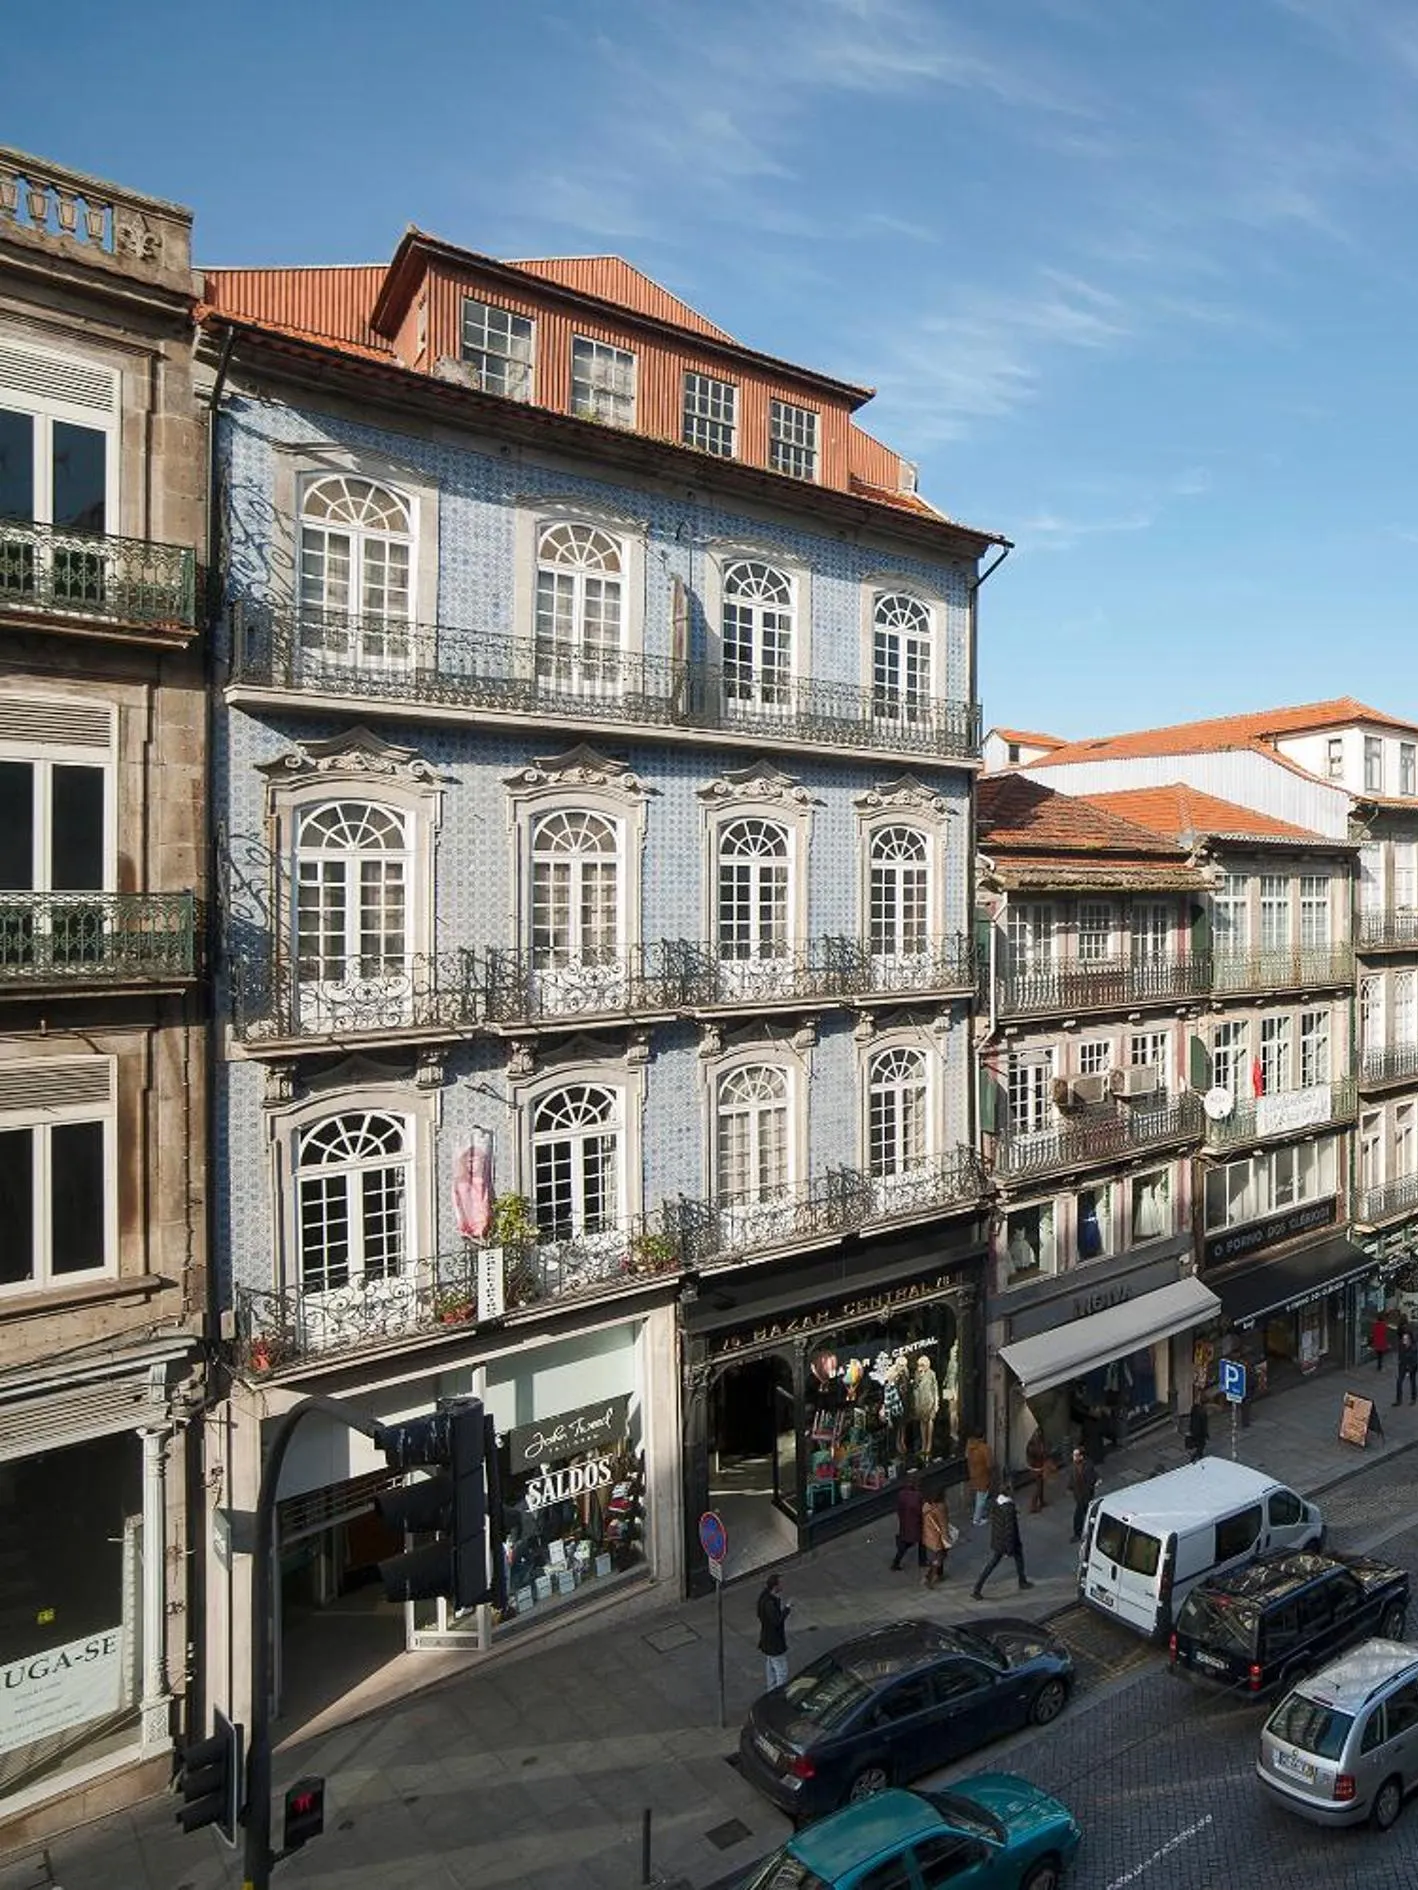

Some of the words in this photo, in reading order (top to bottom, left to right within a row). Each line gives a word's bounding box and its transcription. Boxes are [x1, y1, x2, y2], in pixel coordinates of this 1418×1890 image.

[1213, 1243, 1224, 1257] O
[843, 1281, 931, 1318] CENTRAL
[891, 1335, 939, 1358] CENTRAL
[1225, 1364, 1239, 1390] P
[524, 1457, 613, 1512] SALDOS
